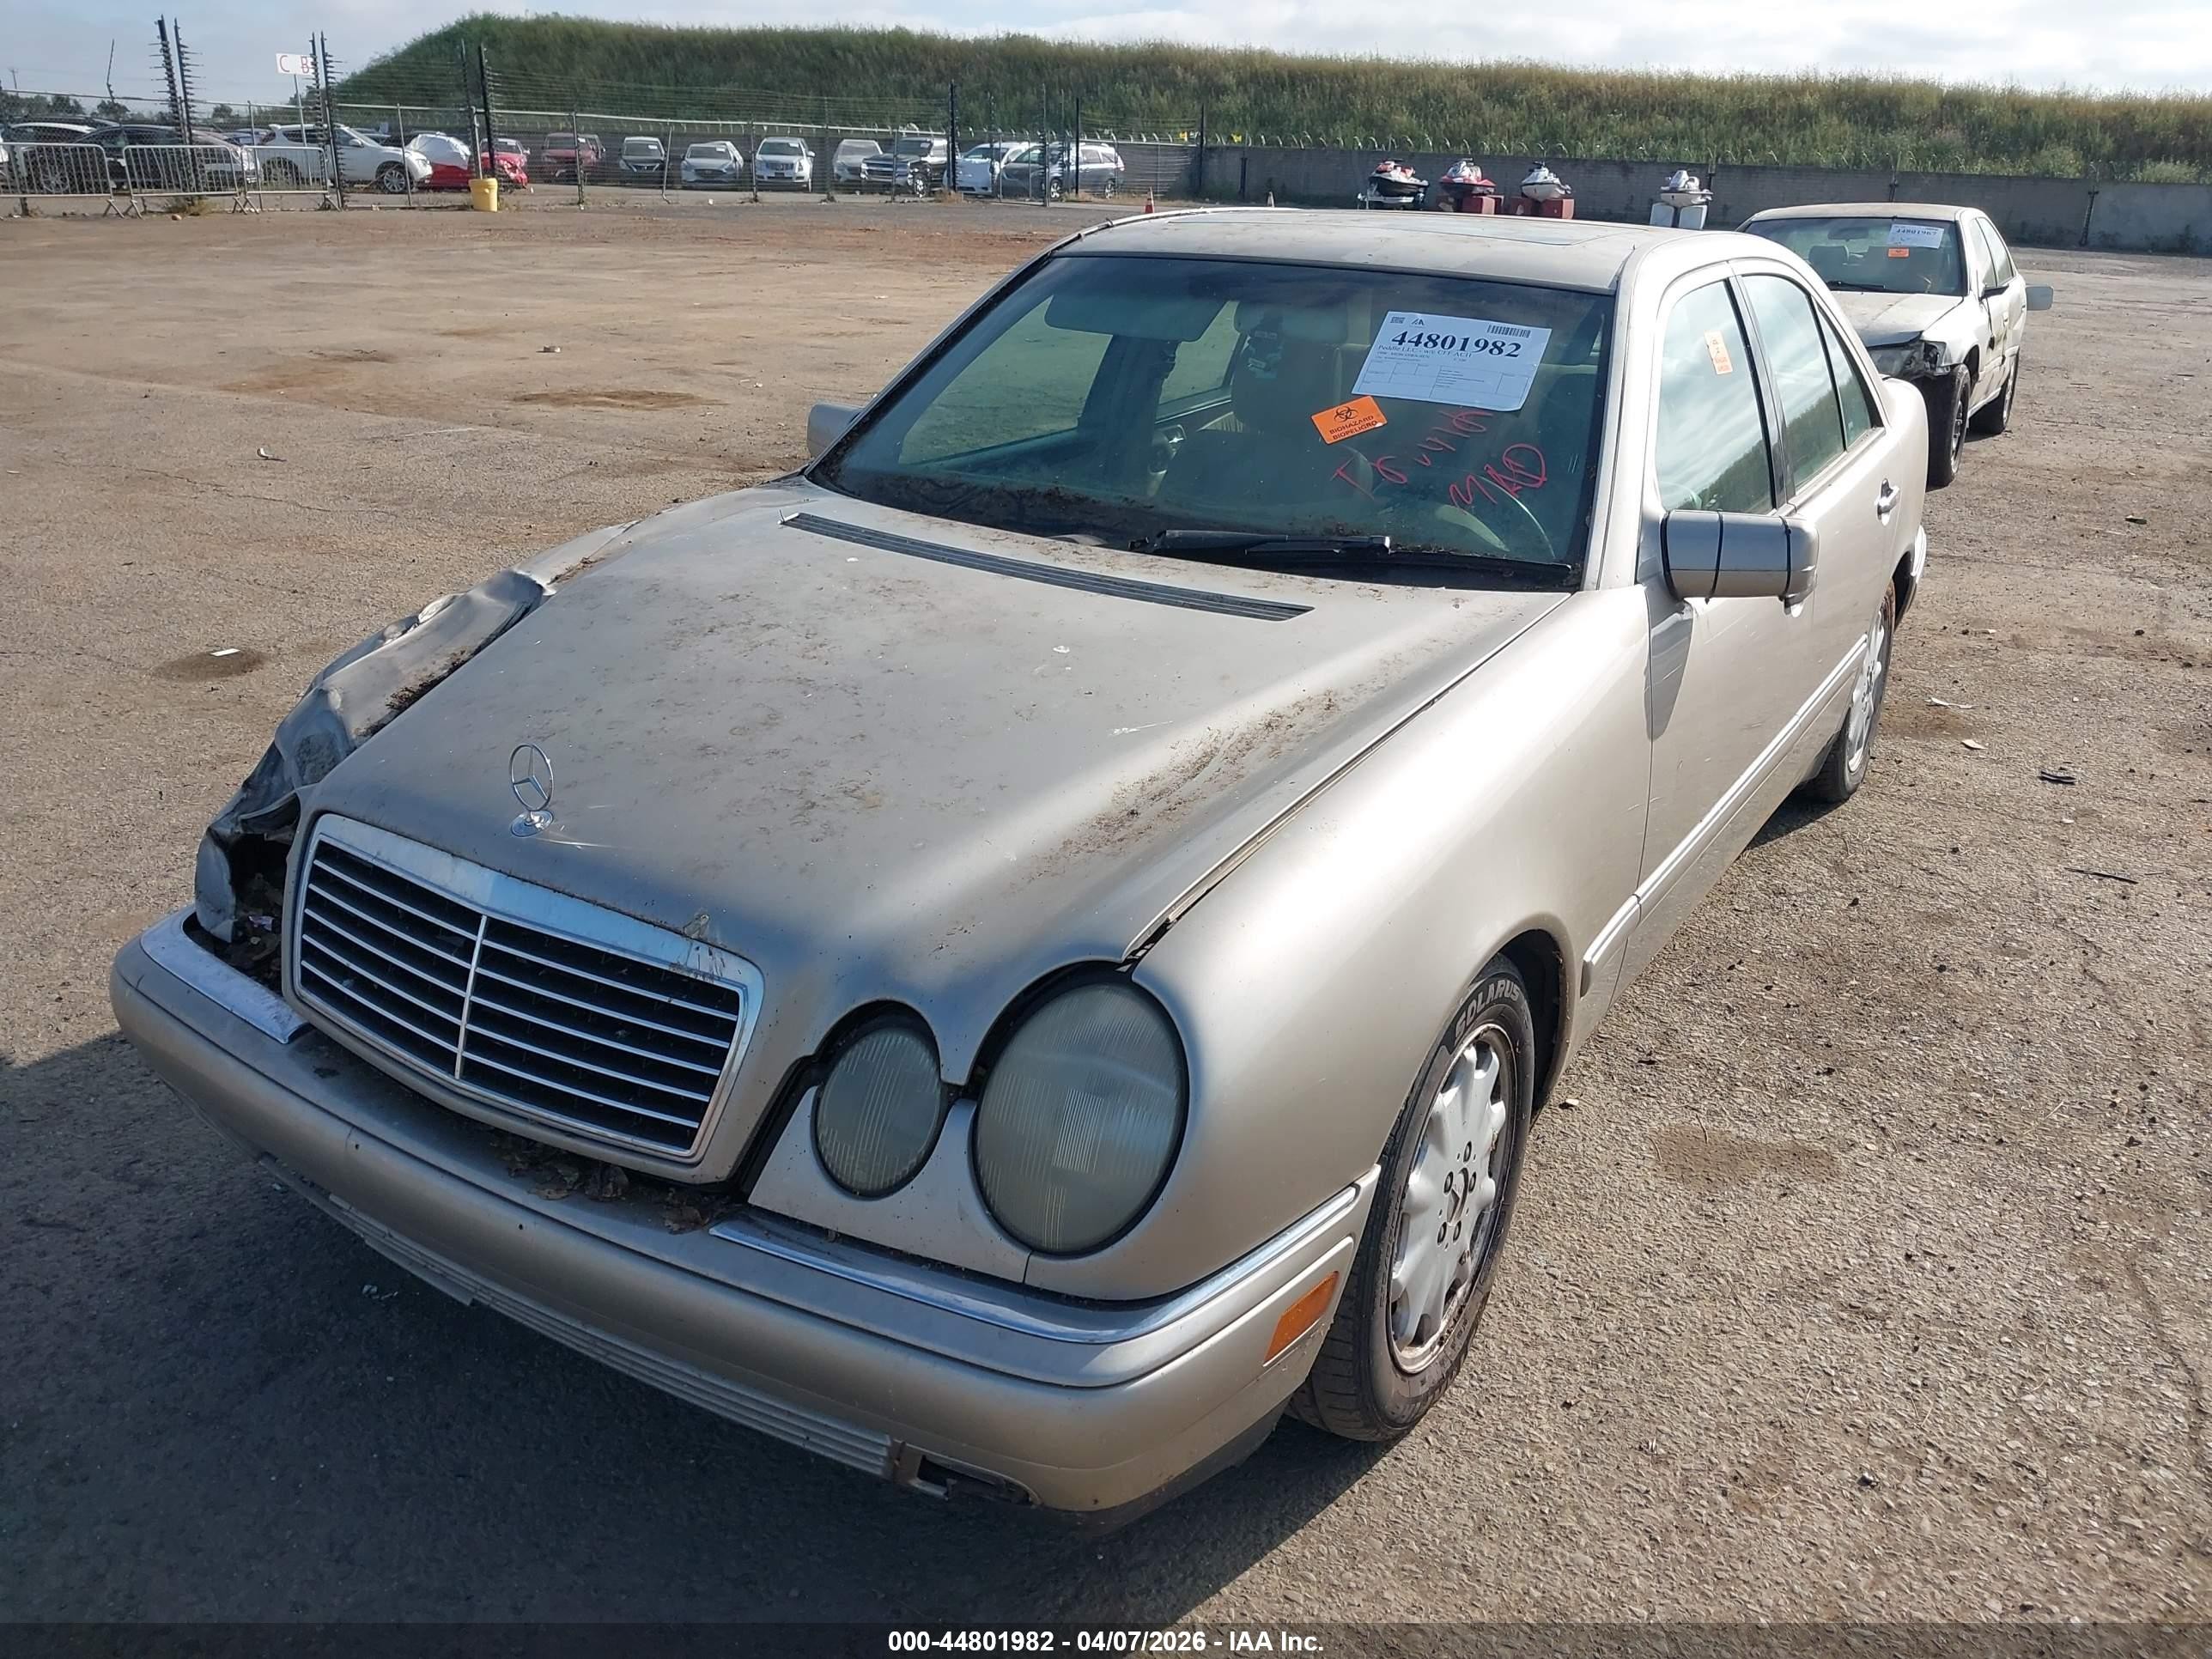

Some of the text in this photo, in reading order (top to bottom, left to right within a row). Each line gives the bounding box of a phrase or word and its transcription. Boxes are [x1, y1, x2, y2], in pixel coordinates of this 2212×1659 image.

[1391, 330, 1522, 359] 44801982
[1329, 415, 1374, 434] BIOHAZARD
[1332, 420, 1378, 441] BIOPELIGRO
[1454, 979, 1520, 1047] SOLARUS
